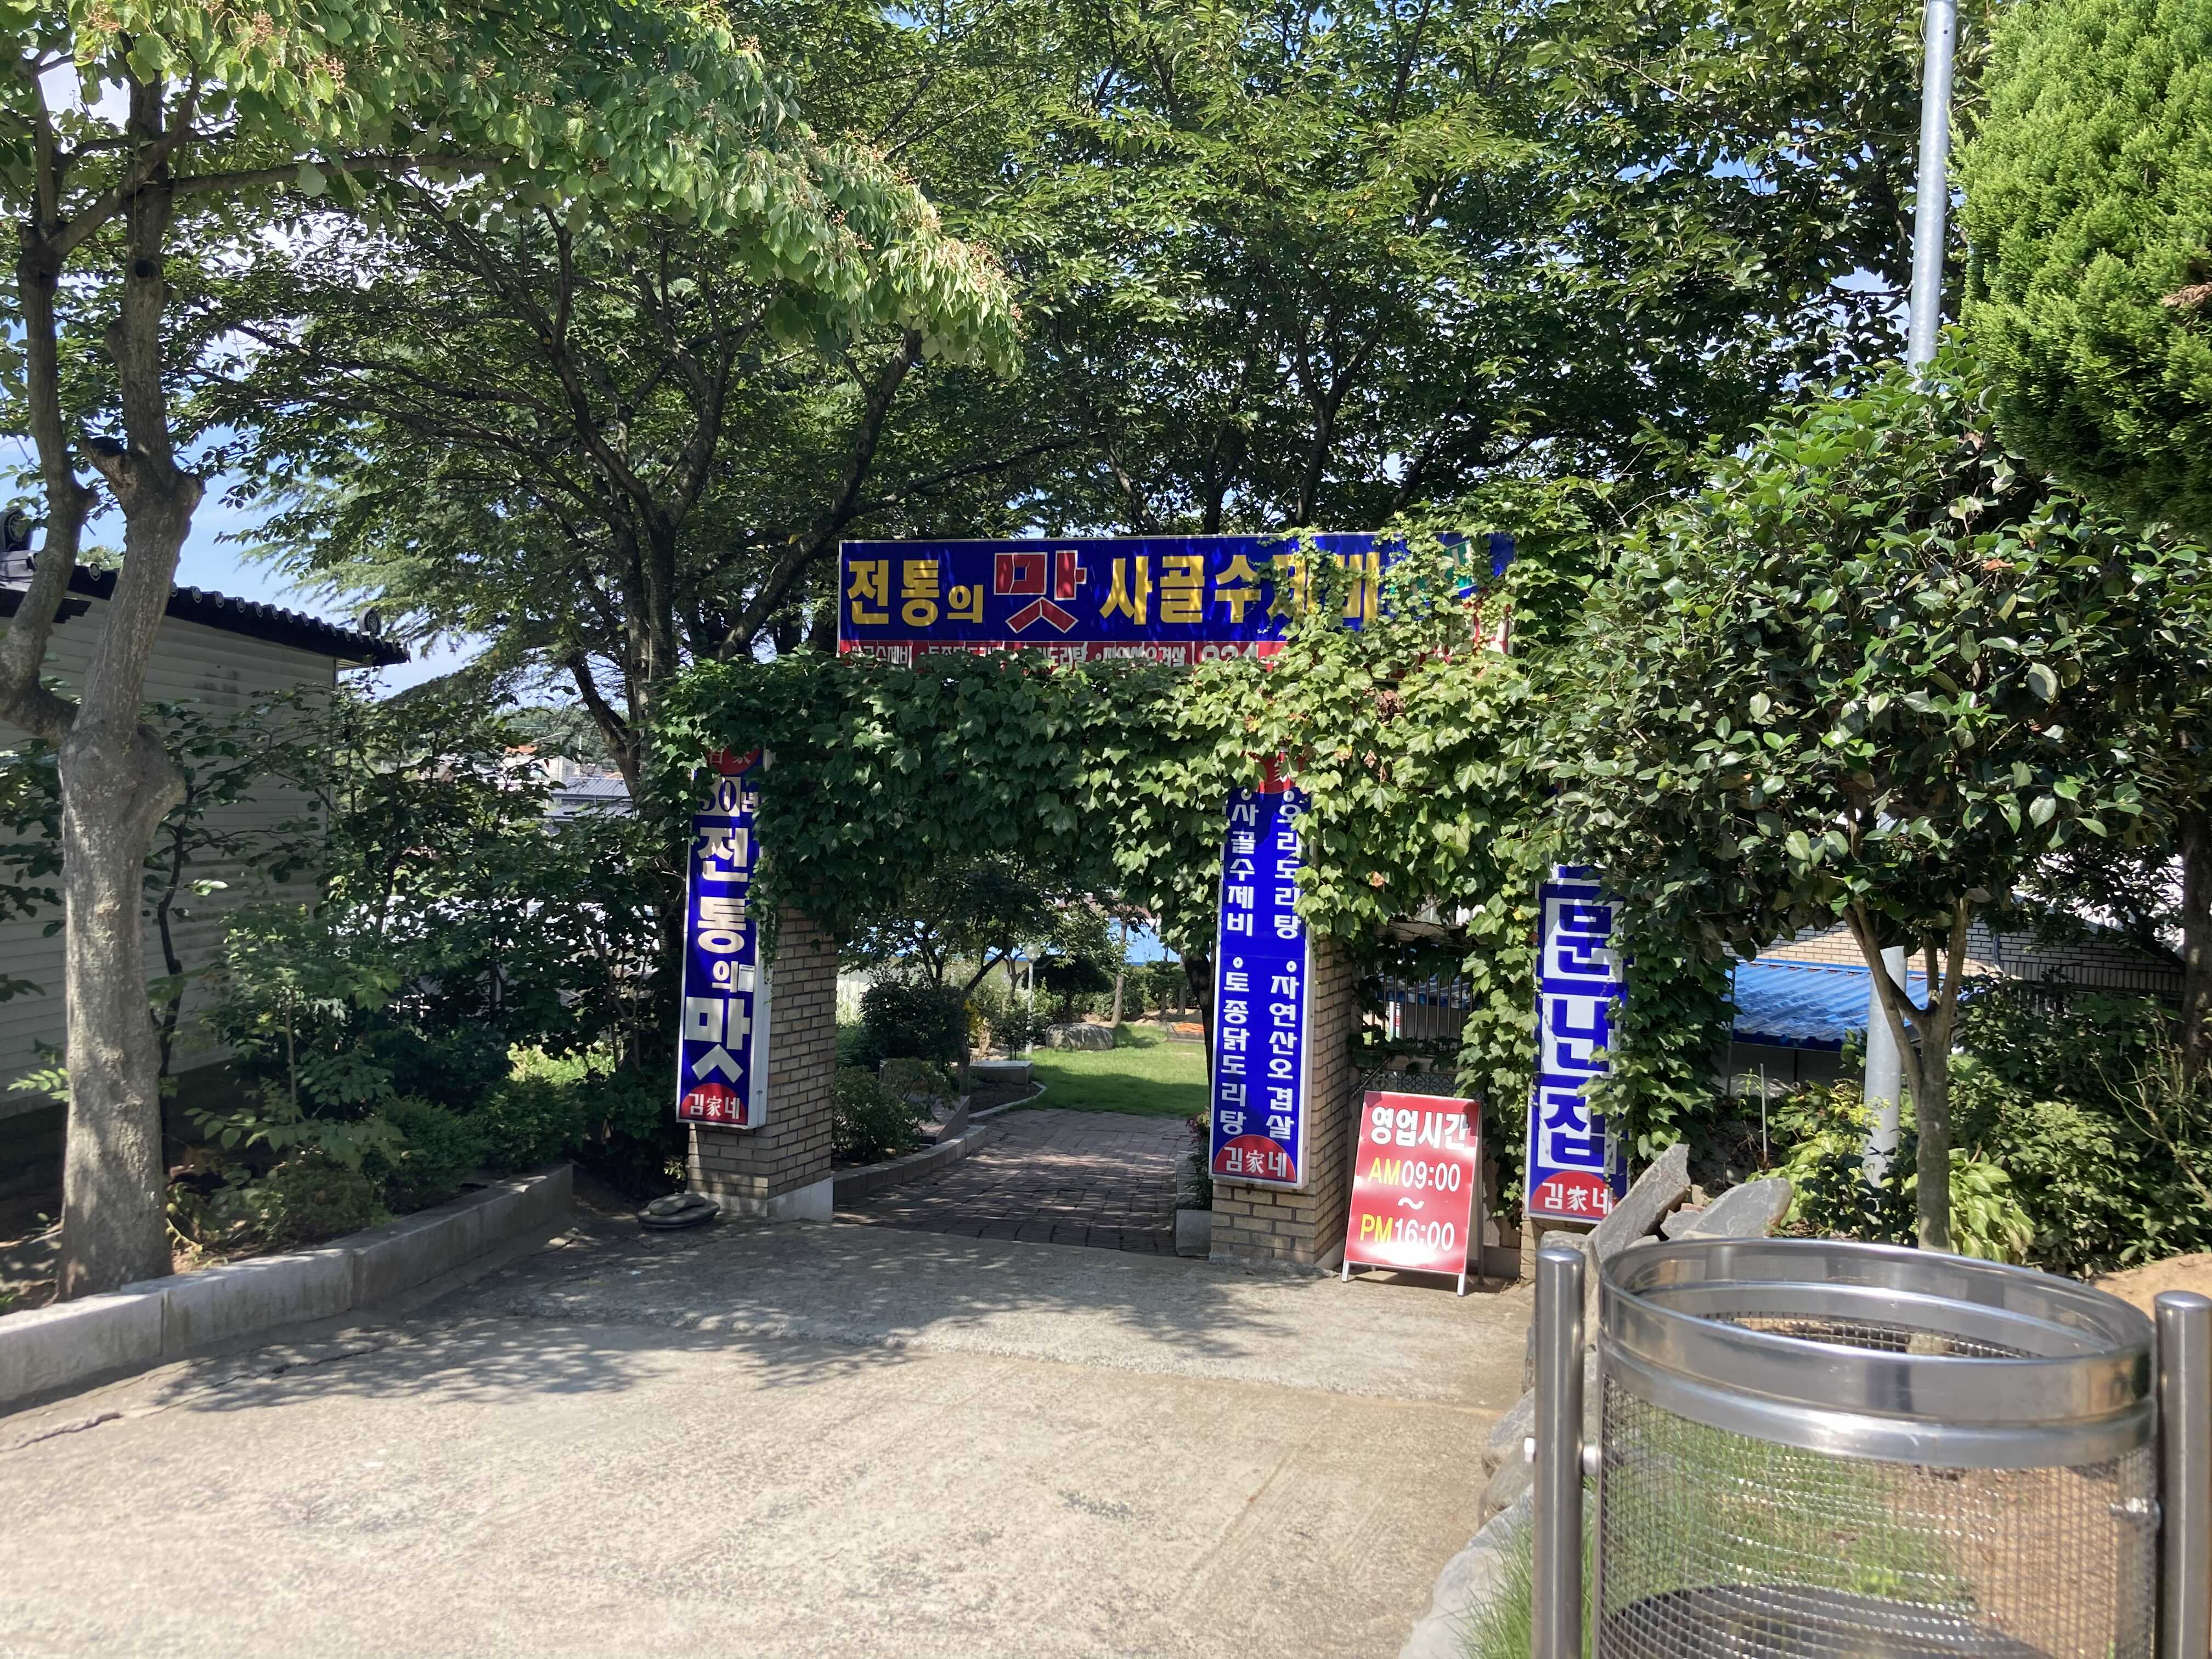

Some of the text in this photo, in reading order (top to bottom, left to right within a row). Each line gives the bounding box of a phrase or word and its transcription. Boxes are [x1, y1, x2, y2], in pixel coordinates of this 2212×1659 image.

[847, 559, 984, 627] 전통의
[993, 550, 1087, 634] 맛
[1099, 551, 1380, 625] 사골수제비
[697, 827, 749, 993] 전통의
[1226, 804, 1260, 938] 사골수제비
[1273, 804, 1302, 940] 오리도리탕
[684, 996, 751, 1084] 맛
[1220, 971, 1250, 1136] 토종닭도리탕
[1265, 975, 1300, 1141] 자연산오겹살
[689, 1092, 740, 1120] 김家네
[1370, 1105, 1469, 1150] 영업시간
[1224, 1146, 1288, 1178] 김家네
